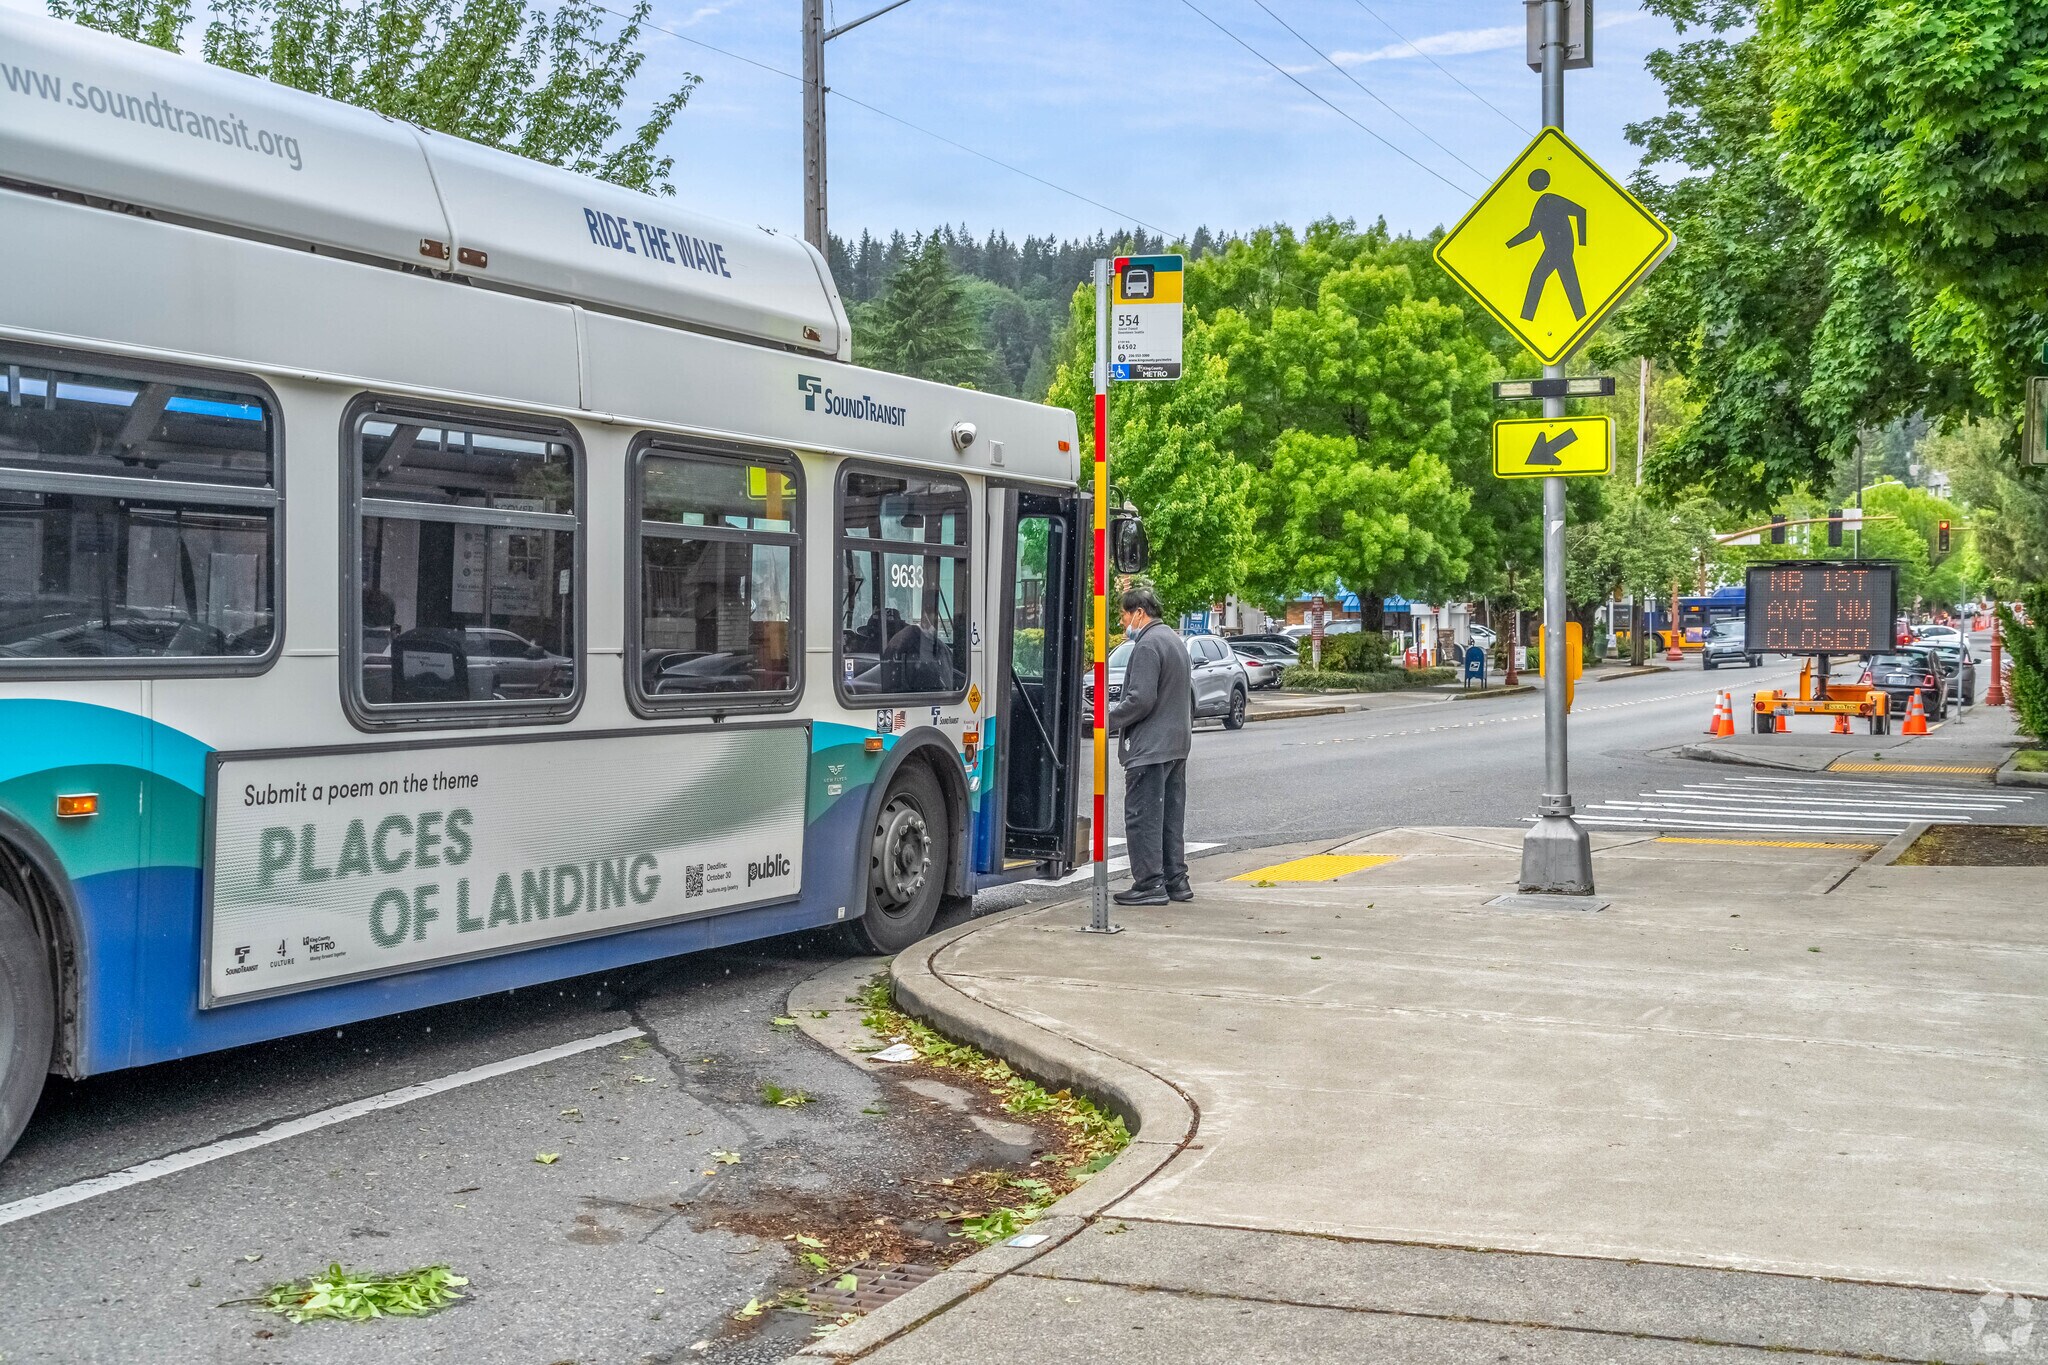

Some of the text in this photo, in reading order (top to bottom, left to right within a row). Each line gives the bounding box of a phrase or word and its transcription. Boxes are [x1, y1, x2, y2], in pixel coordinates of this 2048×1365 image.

[583, 207, 732, 279] RIDE THE WAVE
[1118, 314, 1139, 327] 554
[891, 563, 925, 589] 9633
[1770, 570, 1869, 592] NB 1ST
[1767, 599, 1871, 620] AVE NW
[1766, 628, 1870, 650] CLOSED
[244, 771, 479, 807] Submit a poem on the theme
[258, 808, 474, 889] PLACES
[706, 871, 732, 882] October 30
[747, 853, 791, 887] public
[368, 853, 662, 949] OF LANDING
[310, 941, 336, 953] METRO
[270, 958, 295, 968] CULTURE
